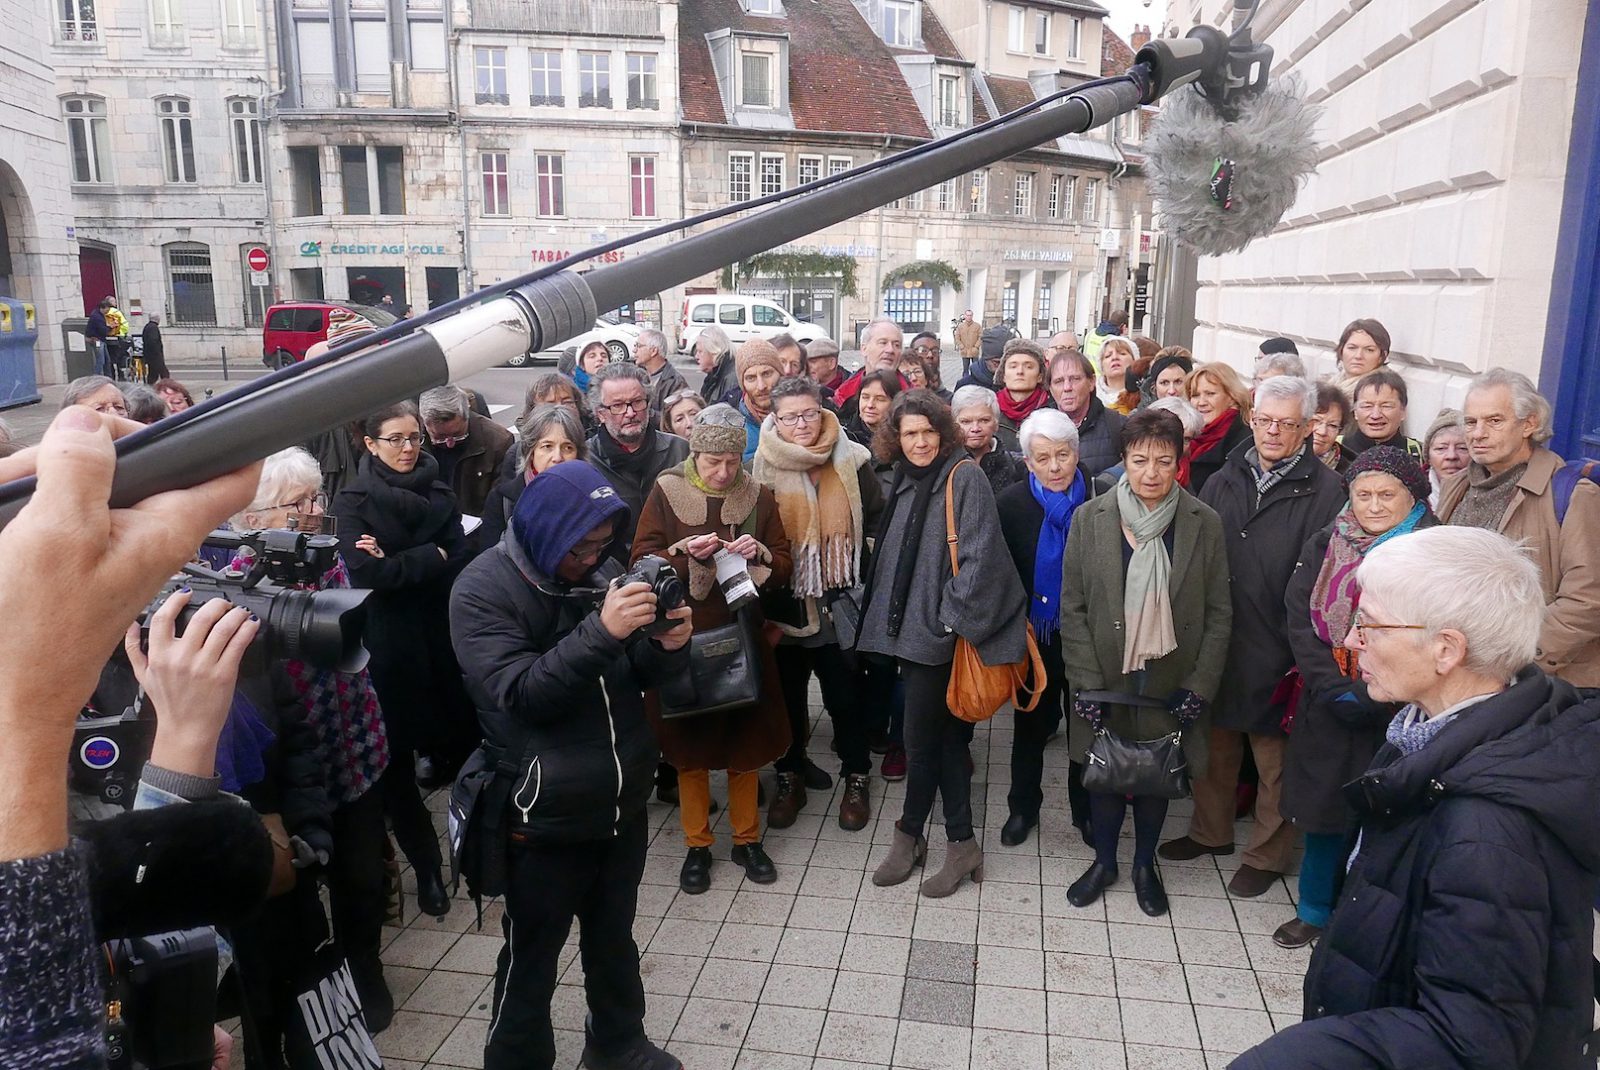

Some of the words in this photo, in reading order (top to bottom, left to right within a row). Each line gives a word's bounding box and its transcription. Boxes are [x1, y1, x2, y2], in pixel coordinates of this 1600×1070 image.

[331, 243, 377, 255] CRÉDIT
[379, 245, 445, 255] AGRCOLE
[1040, 249, 1073, 262] VAUBAN
